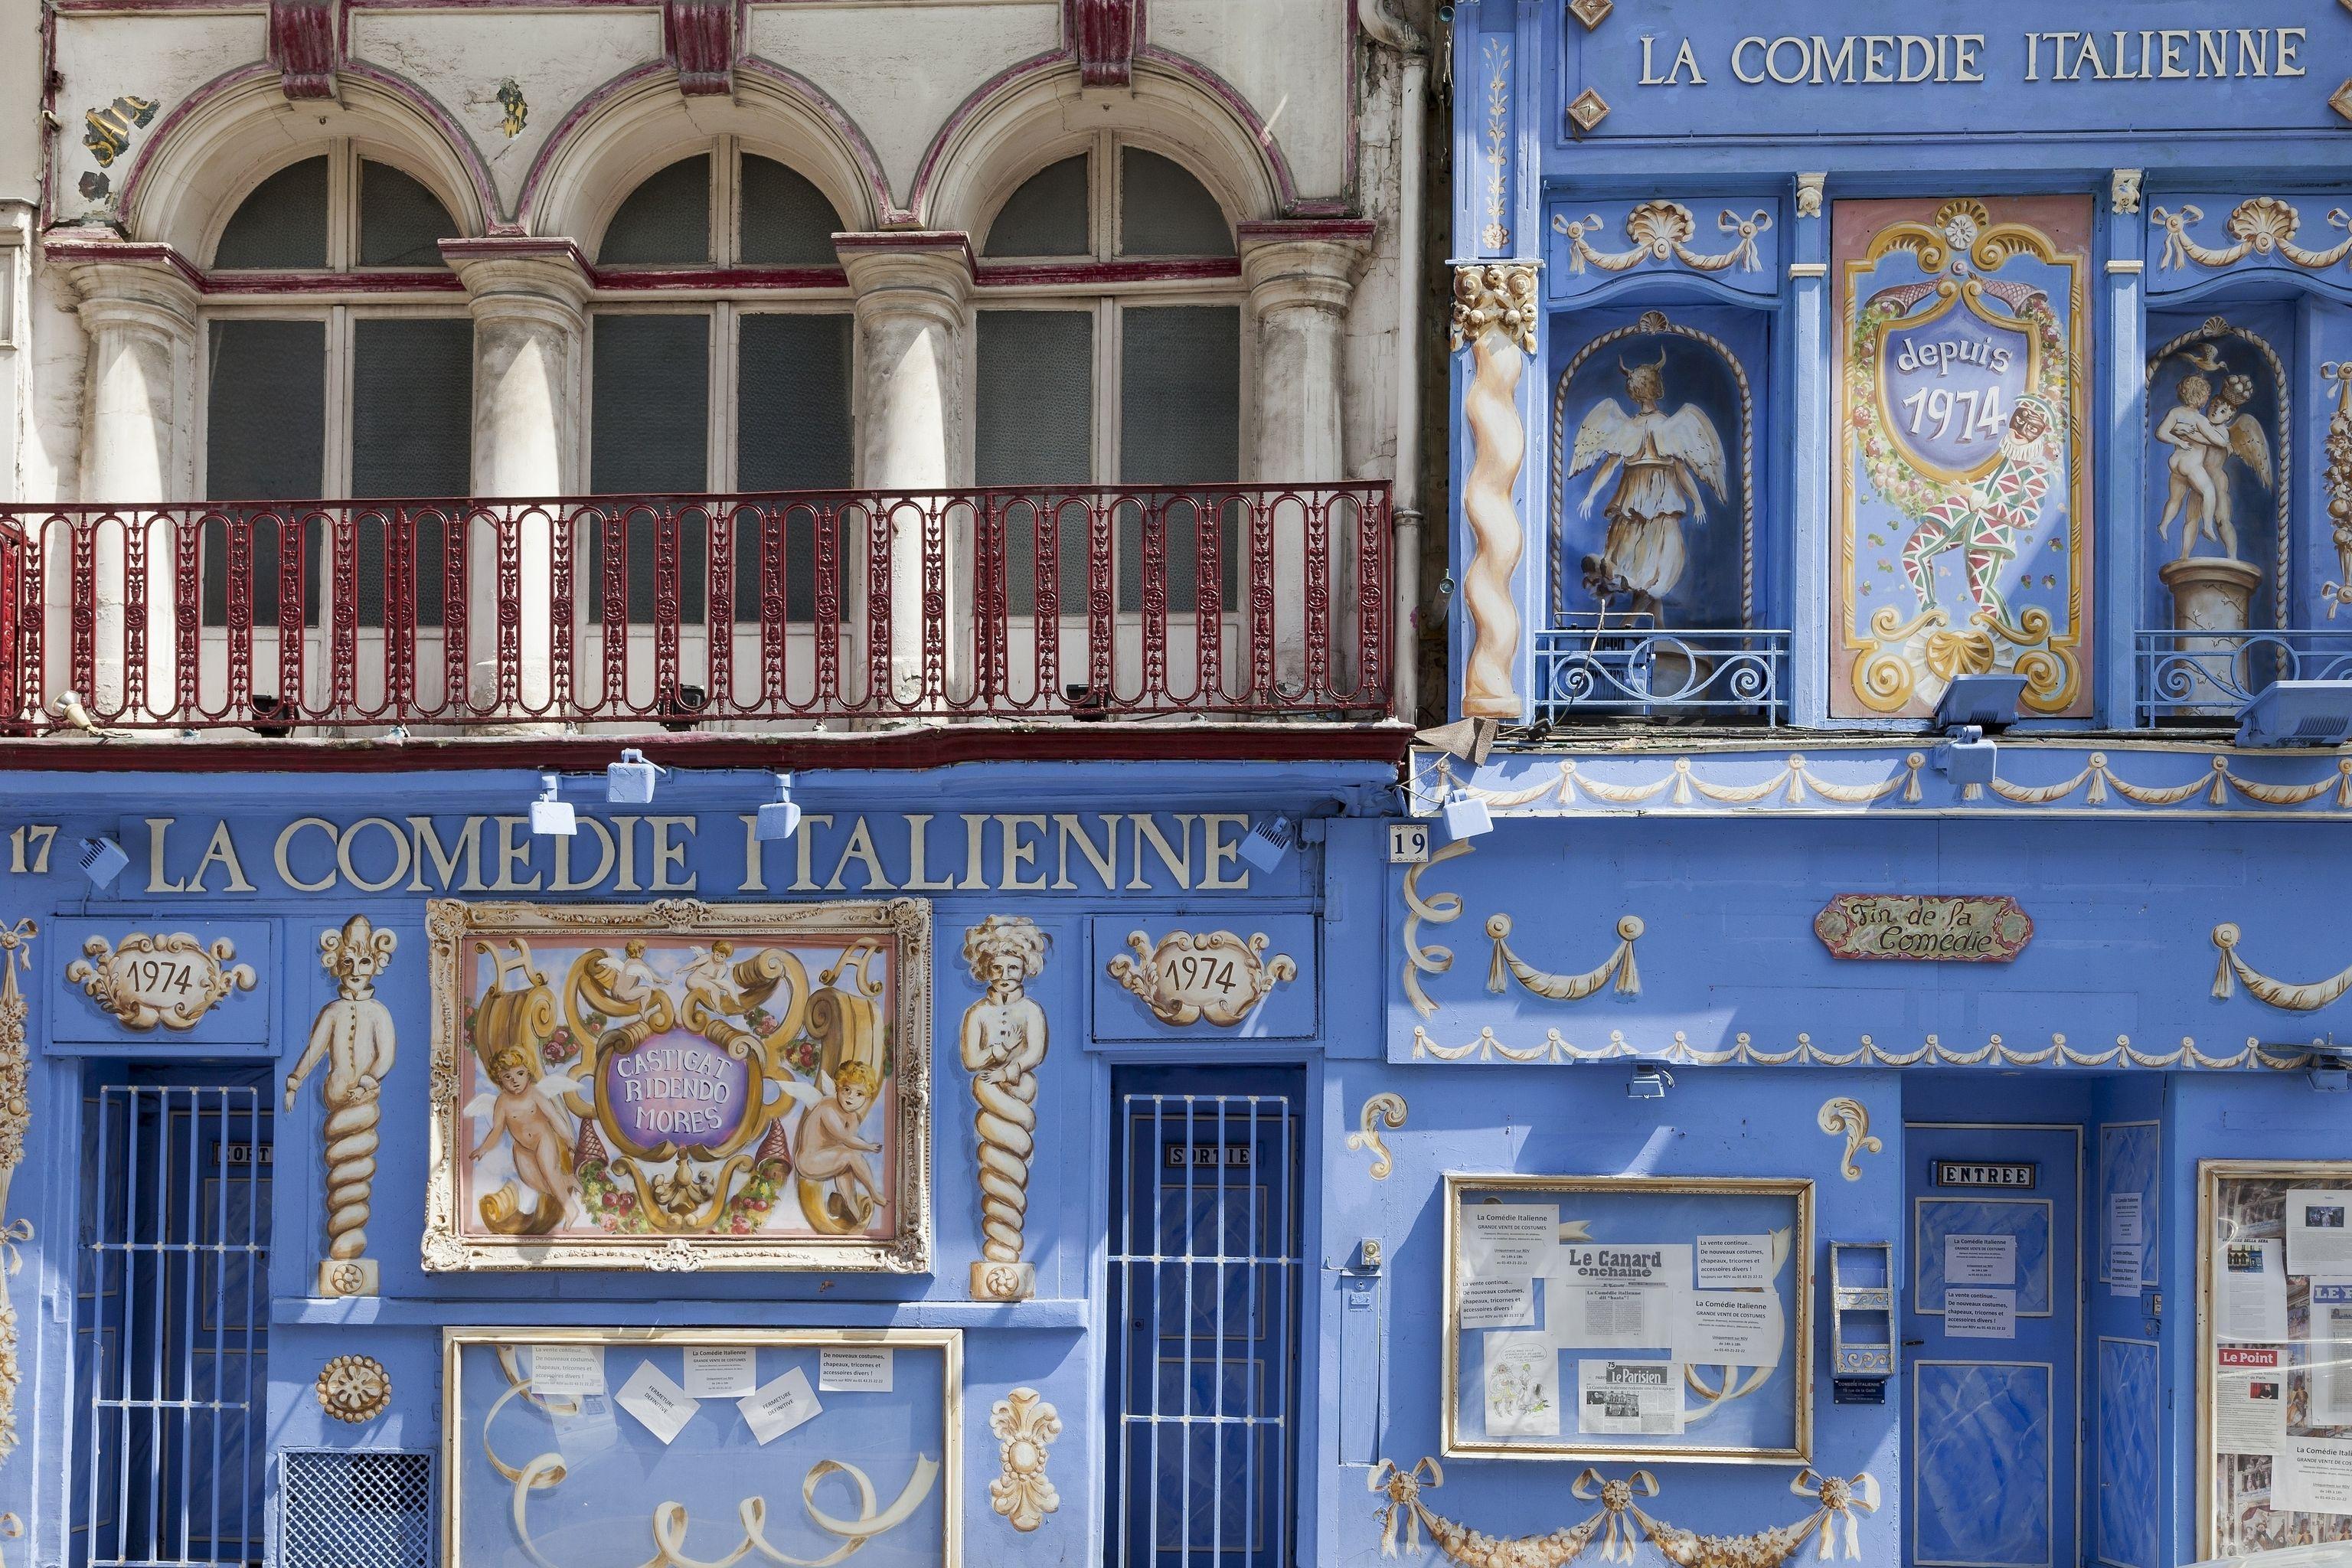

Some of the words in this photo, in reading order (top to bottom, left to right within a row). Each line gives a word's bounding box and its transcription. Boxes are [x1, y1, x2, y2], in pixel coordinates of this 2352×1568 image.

[1638, 35, 1707, 84] LA
[1732, 34, 1985, 83] COMEDIE
[2024, 28, 2306, 81] ITALIENNE
[1897, 337, 2013, 376] depuis
[1902, 386, 2007, 442] 1974
[10, 825, 57, 873] 17
[144, 818, 257, 892] LA
[273, 816, 696, 891] COMEDIE
[737, 814, 1249, 890] ITALIENNE
[1394, 833, 1426, 854] 19
[1851, 901, 1893, 926] Fin
[1907, 904, 1936, 926] de
[1947, 901, 1971, 926] la
[1879, 926, 1992, 952] Comédie
[127, 961, 192, 995] 1974
[1165, 957, 1236, 994] 1974
[616, 1049, 733, 1080] CASTIGAT
[625, 1077, 730, 1104] RIDENDO
[635, 1106, 722, 1134] MORES
[1946, 1167, 2027, 1184] ENTREE
[1570, 1249, 1592, 1266] Le
[1599, 1250, 1661, 1267] Canard
[1705, 1300, 1736, 1308] Comédie
[2314, 1287, 2340, 1299] LE
[2223, 1352, 2237, 1362] Le
[2239, 1352, 2273, 1364] Point
[1612, 1371, 1622, 1383] Le
[1623, 1368, 1661, 1383] Parisien
[644, 1393, 668, 1413] DEFINITIVE
[648, 1385, 674, 1408] FERMETURE
[763, 1391, 792, 1409] FERMETURE
[768, 1399, 794, 1416] DEFINITIVE
